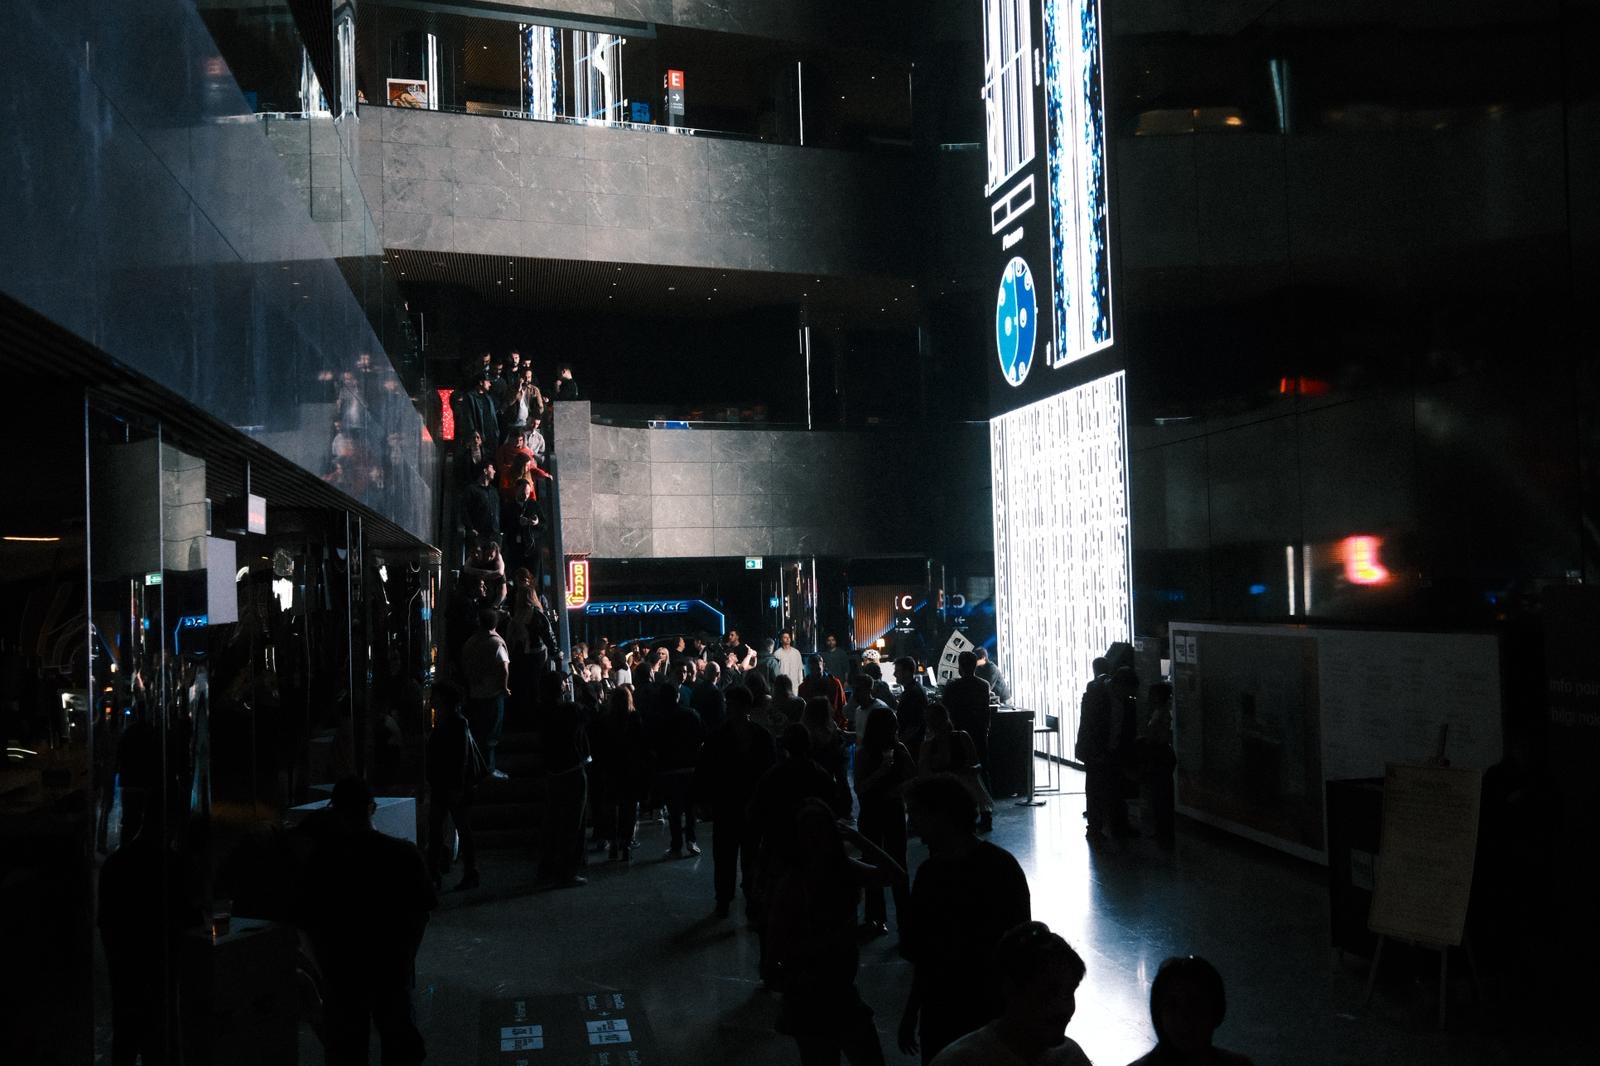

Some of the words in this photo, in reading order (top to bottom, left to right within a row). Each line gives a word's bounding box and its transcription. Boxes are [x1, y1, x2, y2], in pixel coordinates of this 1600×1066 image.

[671, 72, 681, 87] E
[574, 564, 584, 596] BAR
[586, 601, 689, 616] SPORTAGE
[901, 594, 913, 610] C
